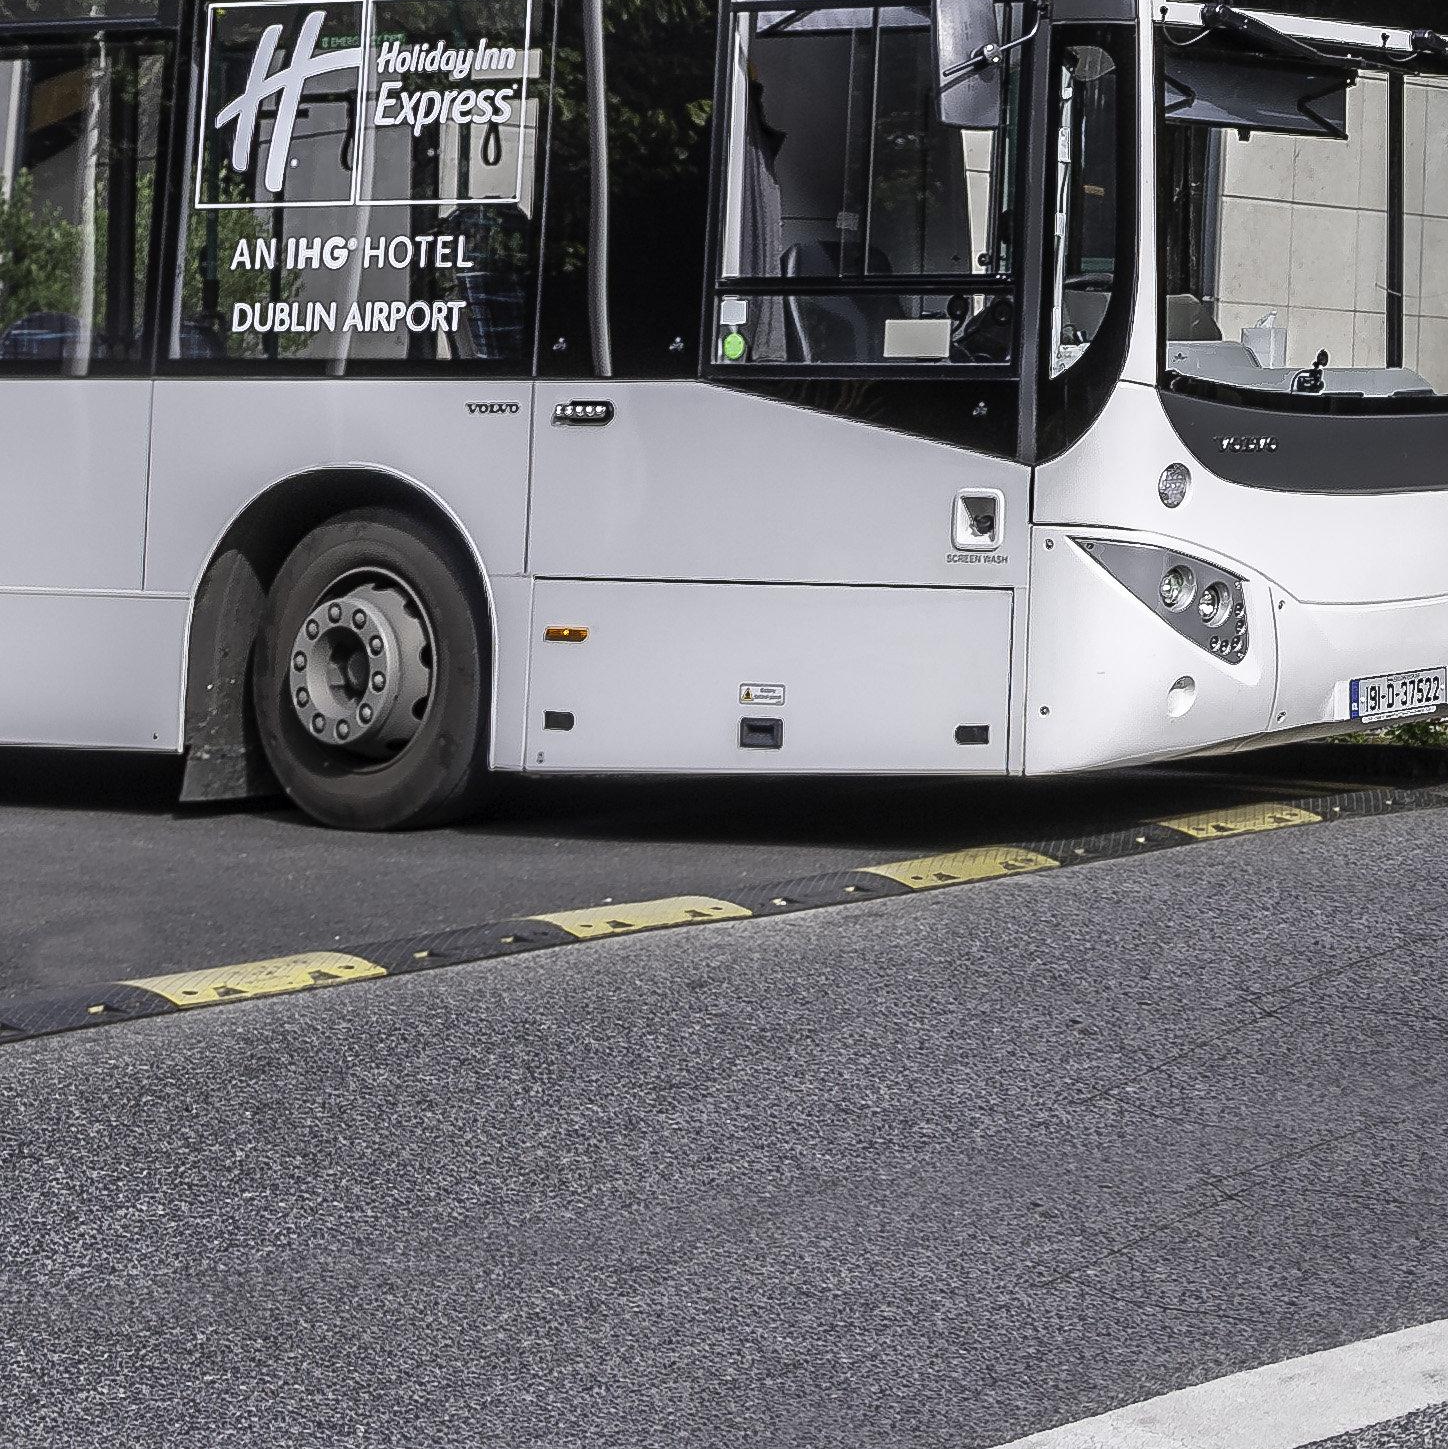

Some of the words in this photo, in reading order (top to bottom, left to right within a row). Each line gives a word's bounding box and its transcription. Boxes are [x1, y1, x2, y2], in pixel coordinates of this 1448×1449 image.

[376, 40, 474, 79] Holiday
[474, 37, 517, 71] Inn
[374, 81, 515, 137] Express
[230, 238, 277, 270] AN
[362, 235, 474, 269] HOTEL
[231, 302, 337, 333] DUBLIN
[342, 300, 467, 333] AIRPORT
[464, 401, 520, 415] VOLVO
[946, 553, 982, 564] SCREEN
[983, 555, 1009, 565] WASH
[1365, 675, 1440, 713] 191-D-37522
